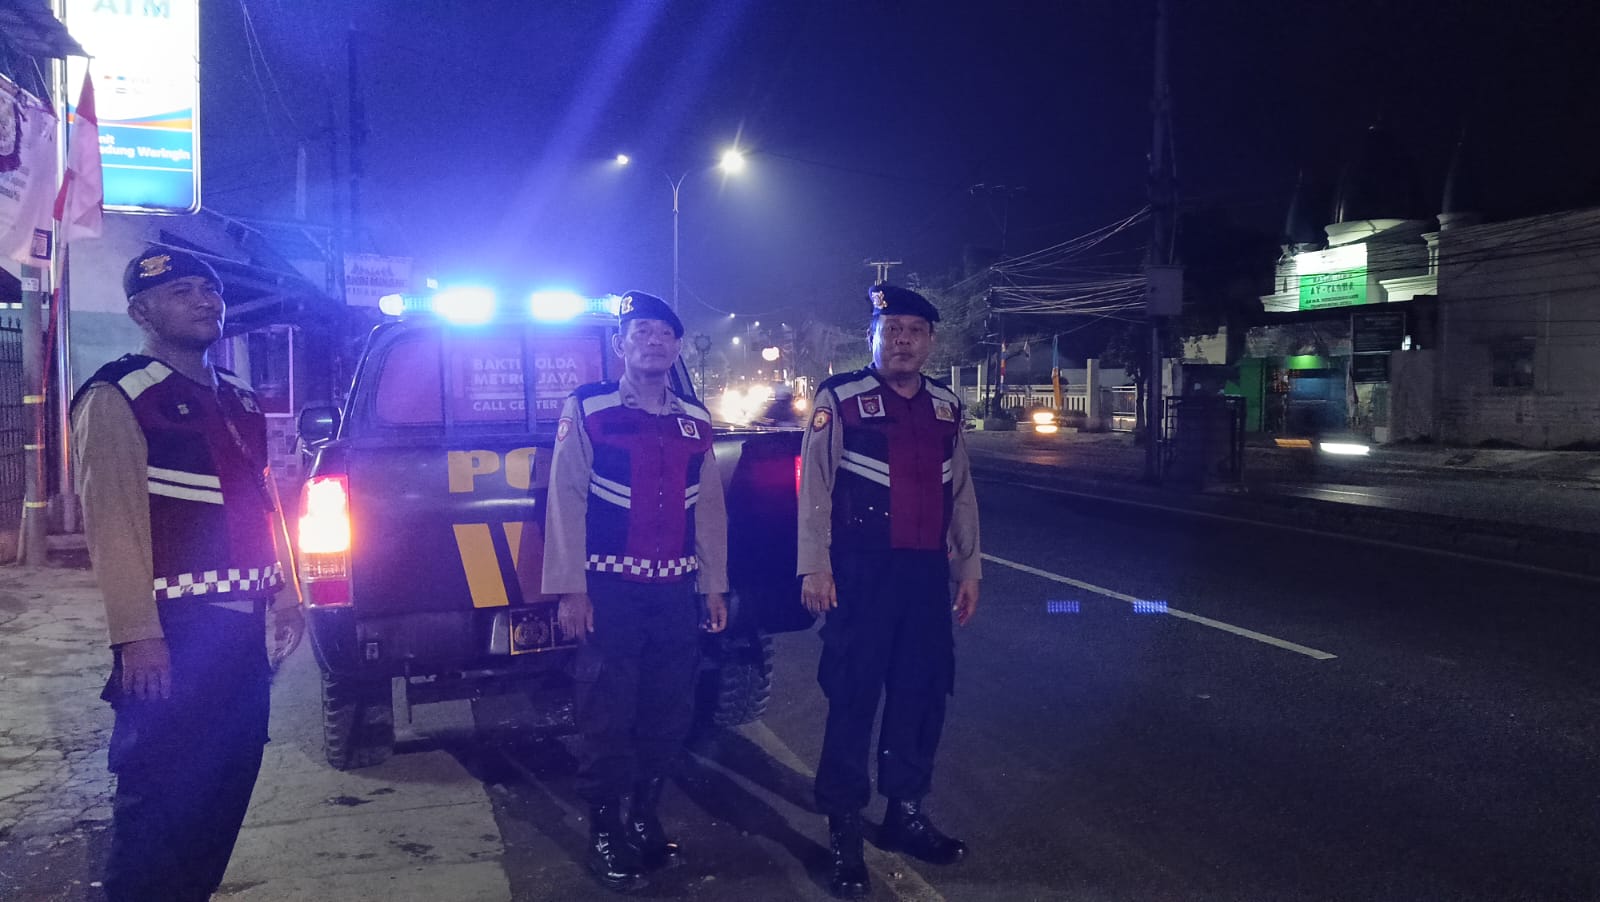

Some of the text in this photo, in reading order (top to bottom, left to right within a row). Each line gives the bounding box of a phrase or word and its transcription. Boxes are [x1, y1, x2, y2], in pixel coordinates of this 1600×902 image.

[98, 134, 115, 145] nit
[473, 357, 577, 370] BAKTI OLDA
[538, 372, 579, 384] JAYA
[473, 400, 559, 411] CALL CETER
